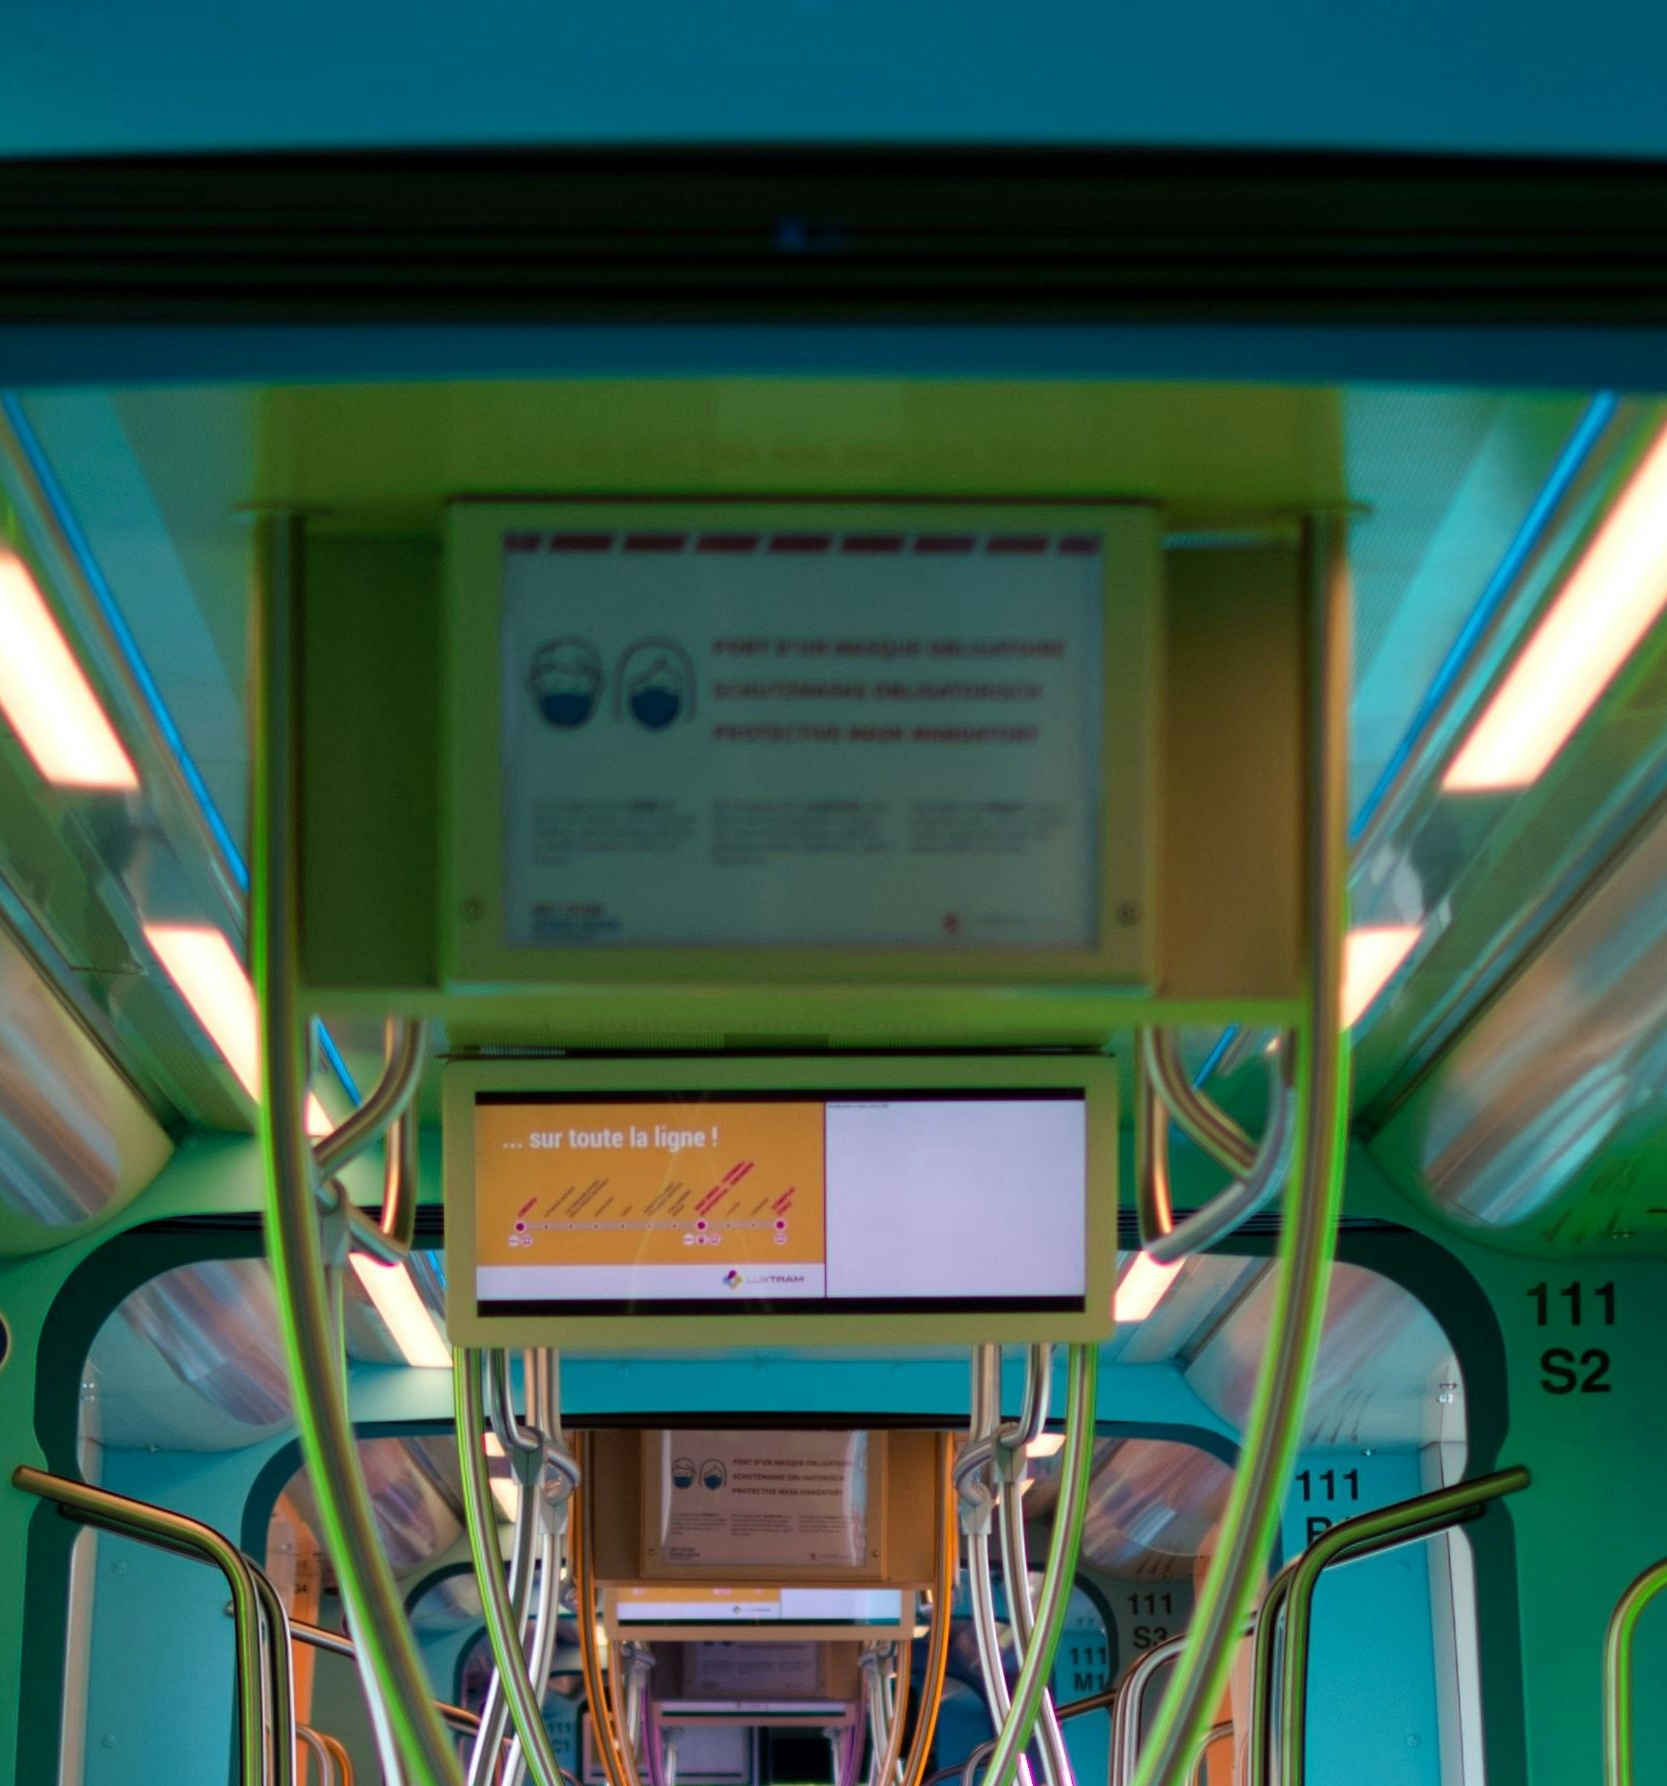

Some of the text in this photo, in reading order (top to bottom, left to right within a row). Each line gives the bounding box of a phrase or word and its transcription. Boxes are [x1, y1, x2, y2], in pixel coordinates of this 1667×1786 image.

[529, 1131, 563, 1149] sur
[568, 1128, 623, 1148] toute
[629, 1126, 648, 1148] la
[654, 1124, 706, 1153] ligne
[1526, 1281, 1615, 1327] 111
[1540, 1347, 1612, 1395] S2
[1296, 1469, 1358, 1501] 111
[1129, 1593, 1172, 1615] 111
[1134, 1625, 1168, 1649] S3
[1071, 1648, 1107, 1665] 111
[1074, 1673, 1105, 1692] M1
